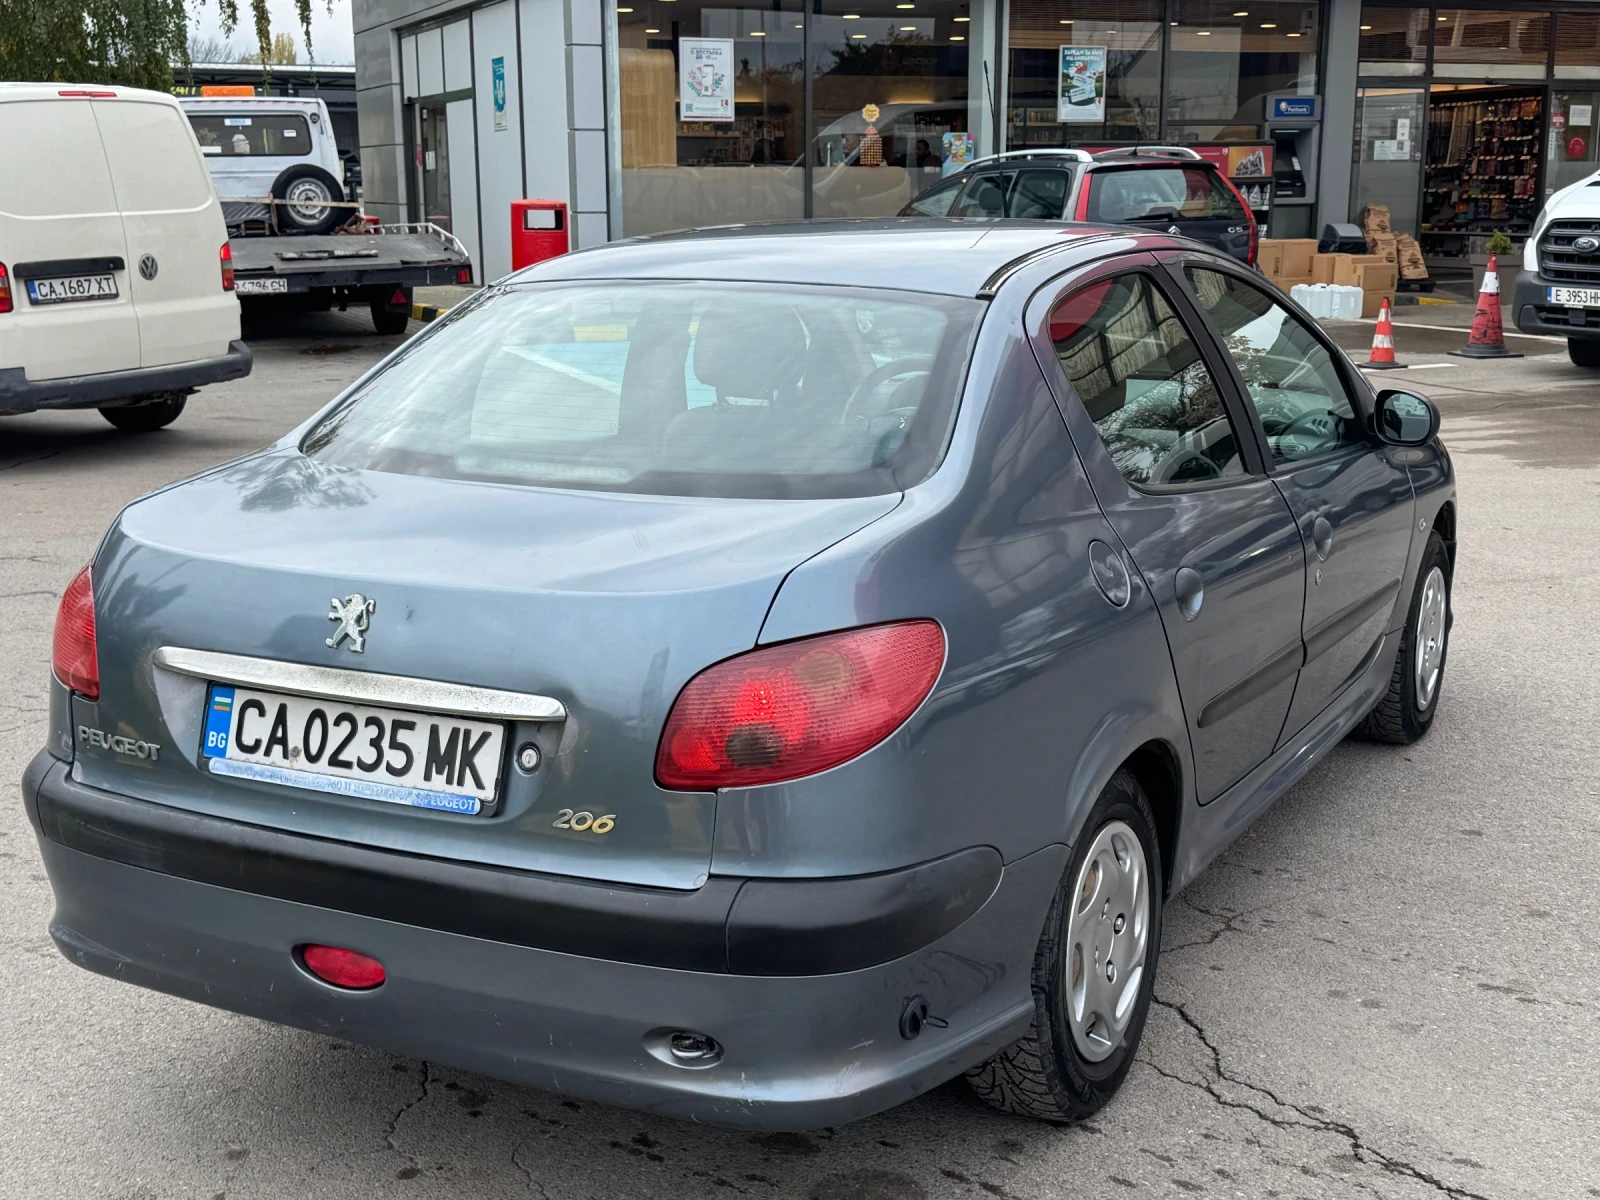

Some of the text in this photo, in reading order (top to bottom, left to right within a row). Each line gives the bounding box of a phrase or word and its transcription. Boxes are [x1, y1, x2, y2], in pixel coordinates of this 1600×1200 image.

[95, 276, 112, 293] XT
[1555, 289, 1561, 301] E
[1566, 290, 1588, 303] 3953
[78, 725, 160, 761] PEUGEOT
[206, 731, 227, 749] BG
[234, 698, 290, 760] CA
[302, 707, 417, 778] 0235
[423, 723, 493, 791] MK
[424, 793, 475, 811] PEUGEOT
[552, 808, 617, 834] 206
